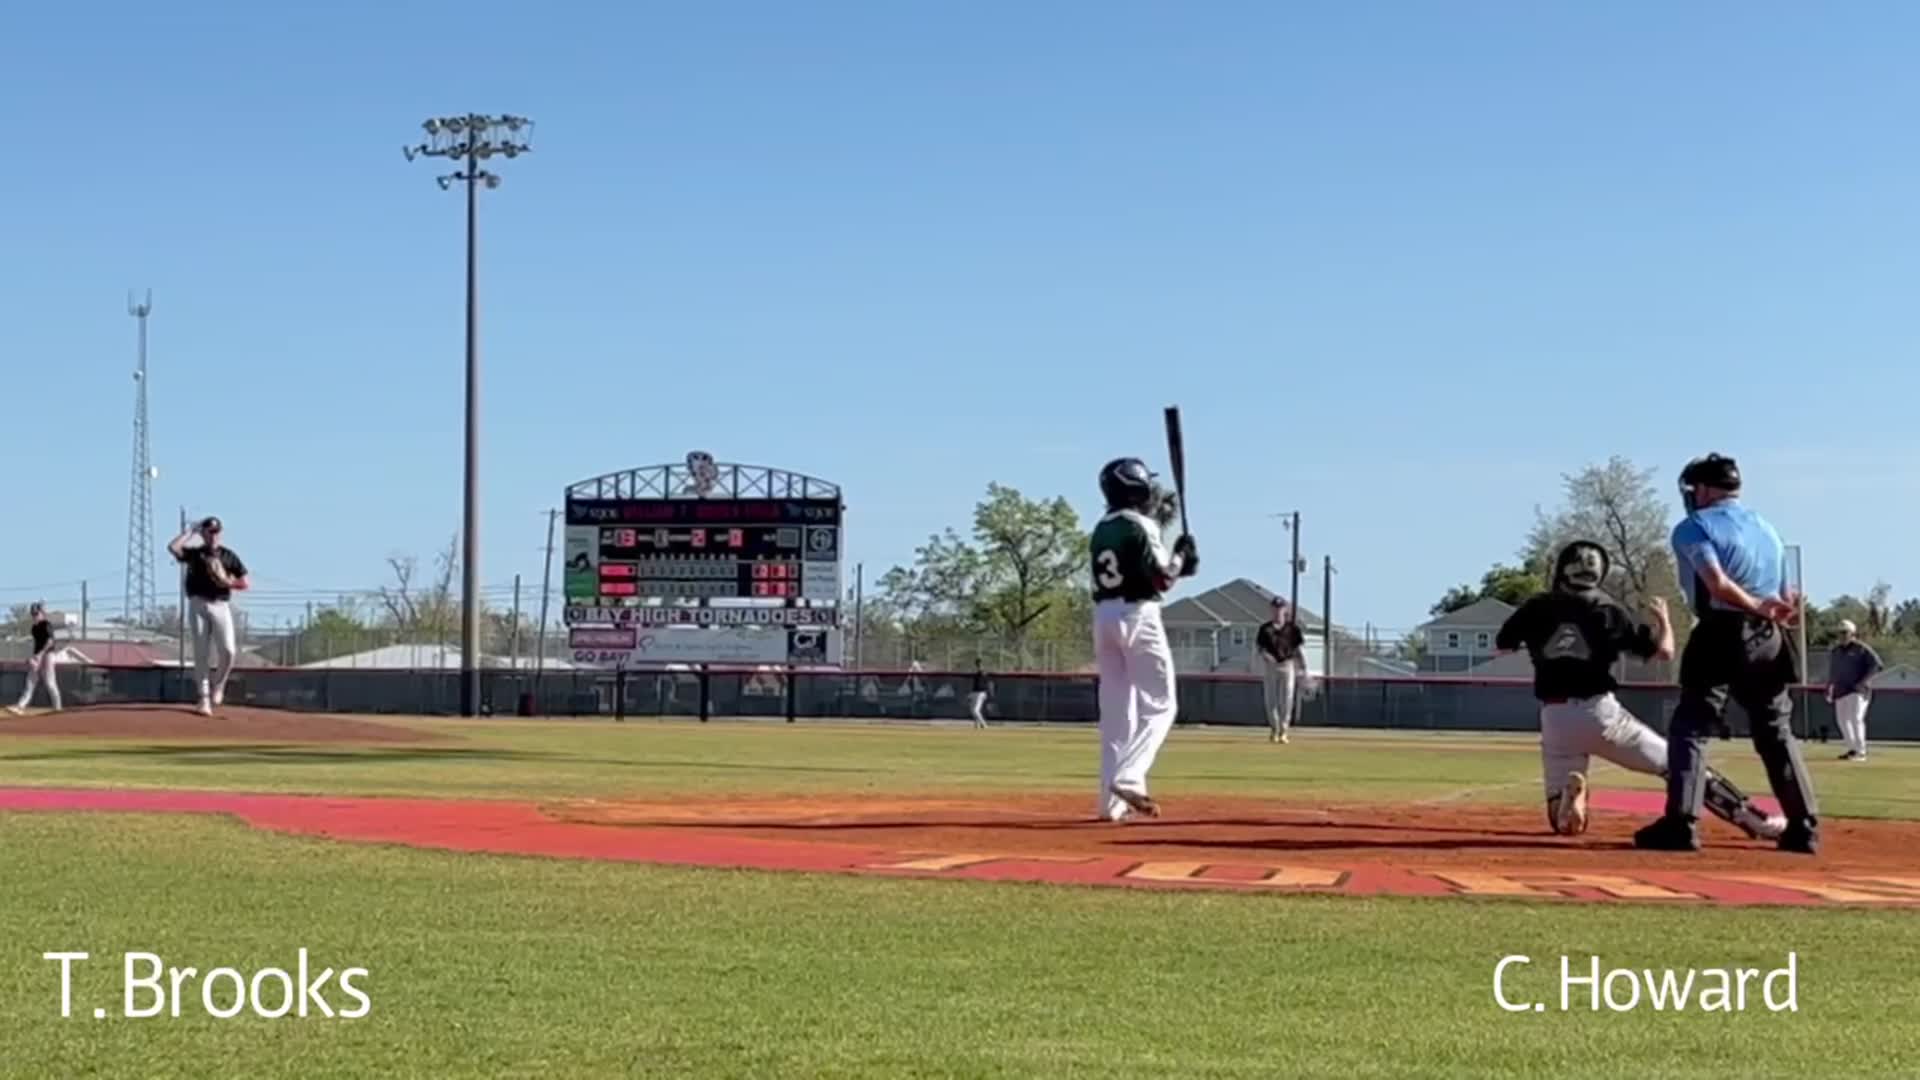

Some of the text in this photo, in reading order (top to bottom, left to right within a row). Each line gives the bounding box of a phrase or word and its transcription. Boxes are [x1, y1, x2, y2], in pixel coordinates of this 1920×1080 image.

[1098, 549, 1124, 589] 3
[586, 608, 813, 622] BAY HIGH TORNADOES
[575, 651, 596, 663] GO
